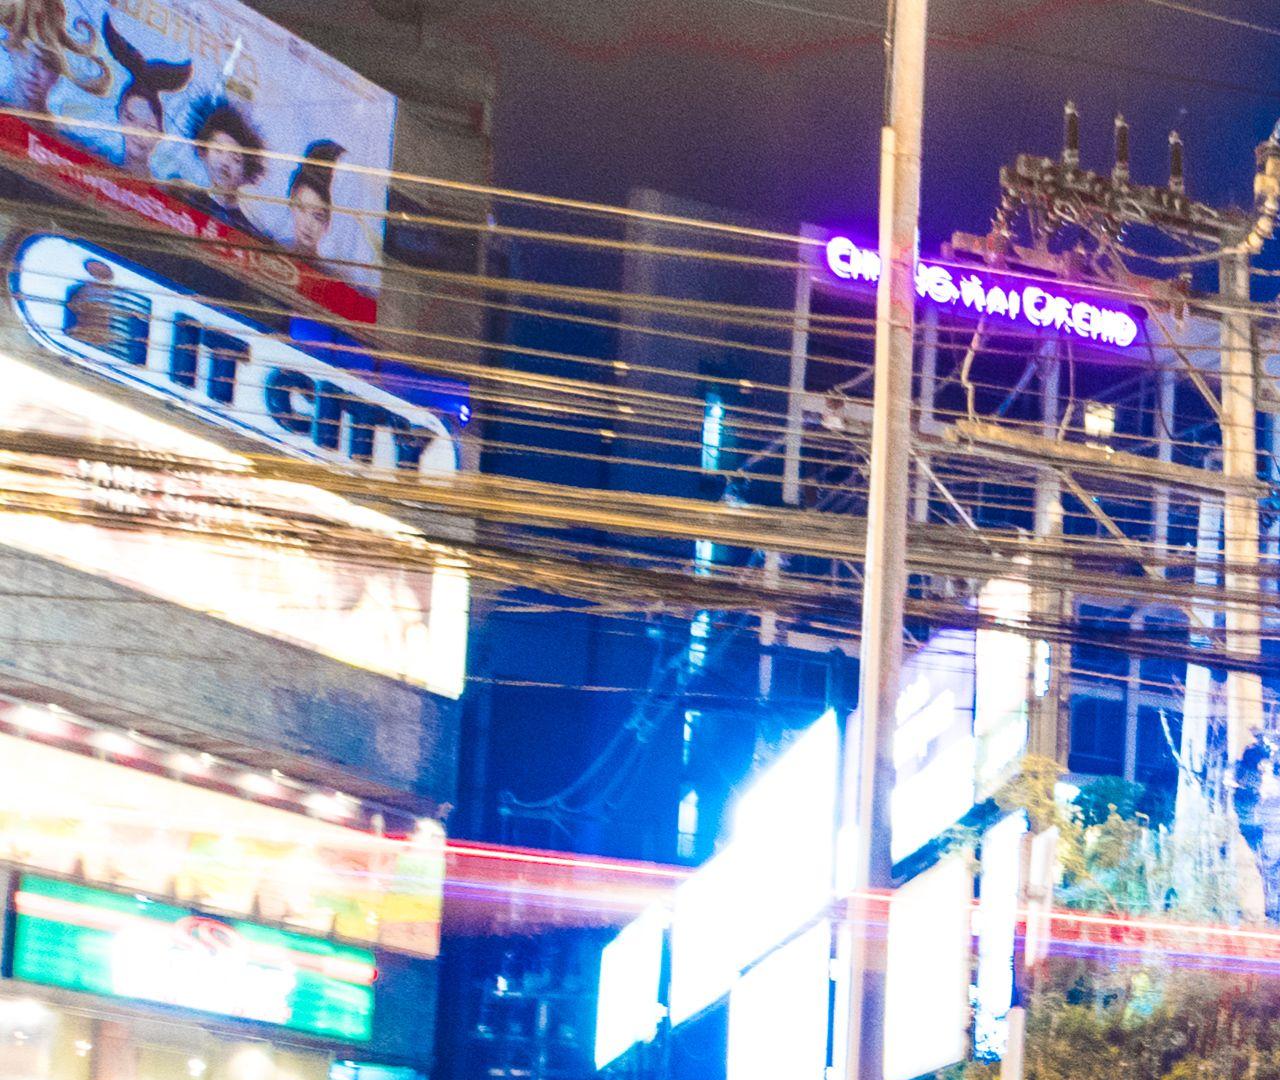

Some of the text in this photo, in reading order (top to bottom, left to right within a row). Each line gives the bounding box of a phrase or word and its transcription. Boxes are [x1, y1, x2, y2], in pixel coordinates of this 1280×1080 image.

[960, 274, 1020, 320] MAI
[170, 311, 433, 470] IT CITY
